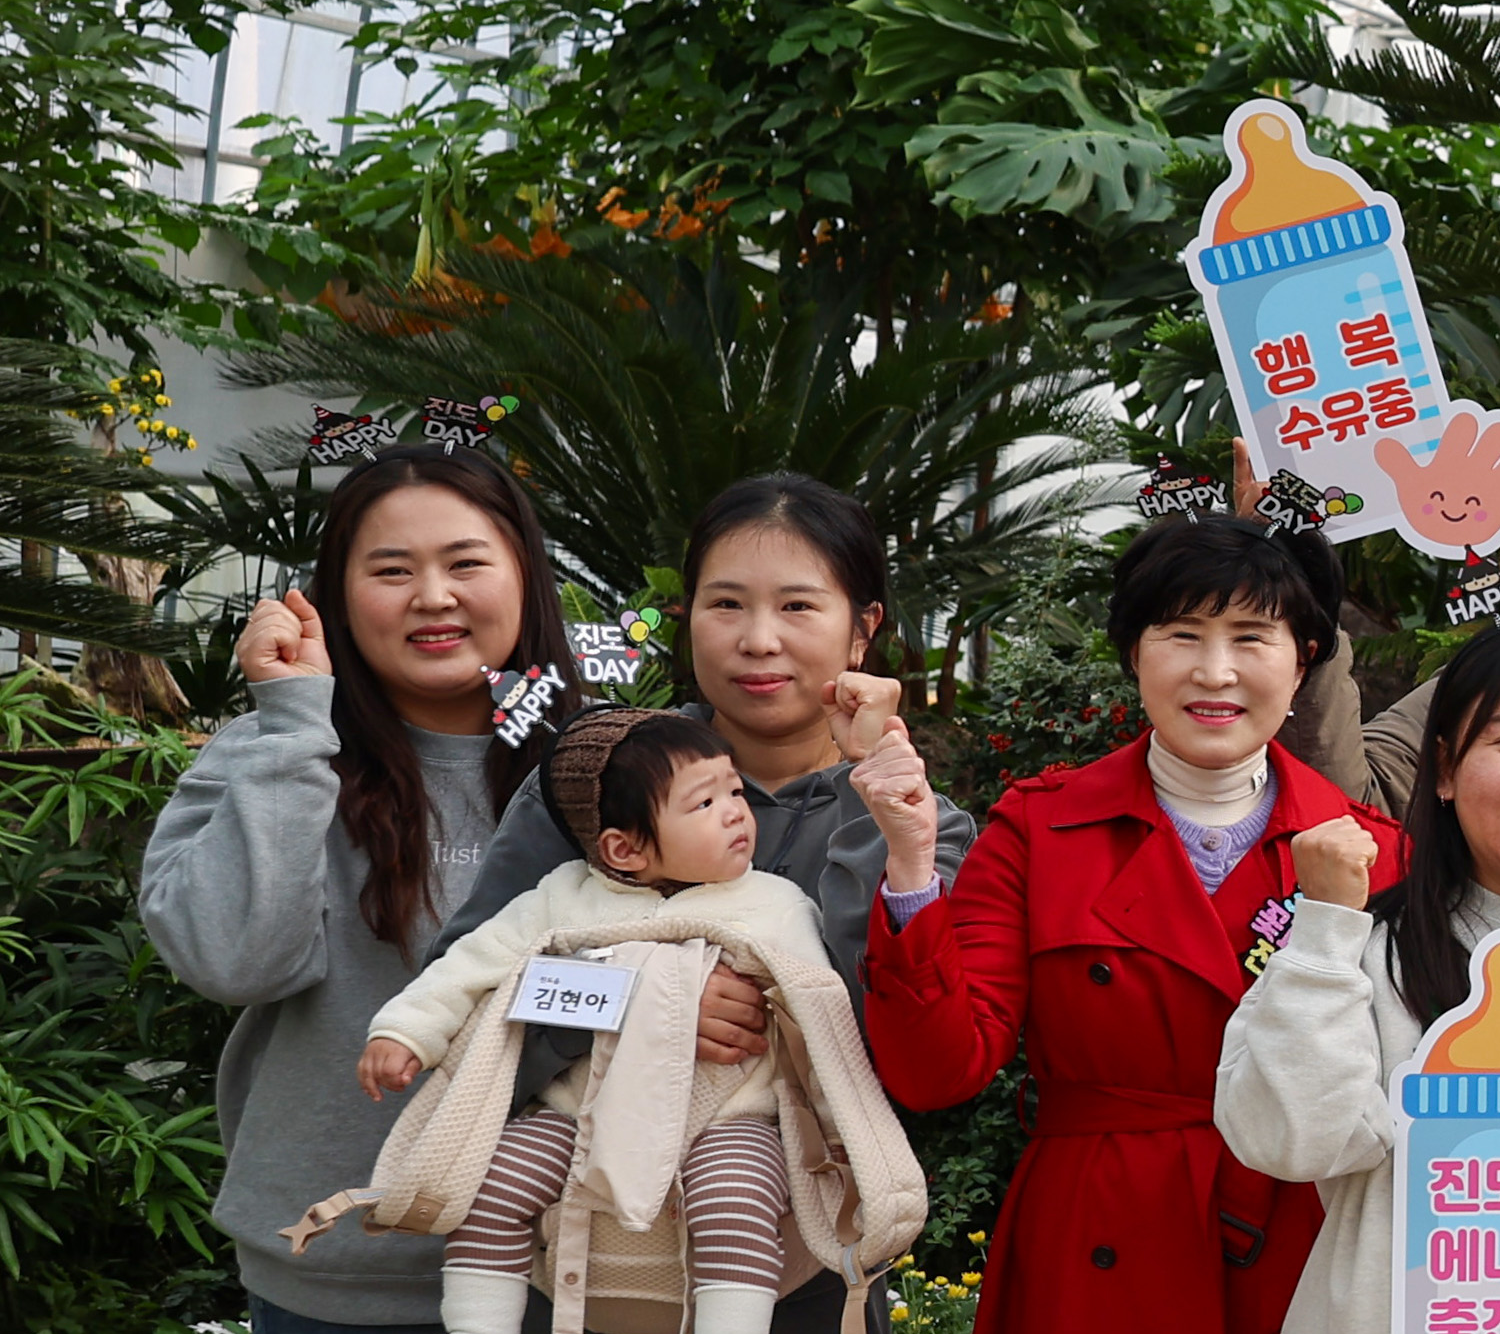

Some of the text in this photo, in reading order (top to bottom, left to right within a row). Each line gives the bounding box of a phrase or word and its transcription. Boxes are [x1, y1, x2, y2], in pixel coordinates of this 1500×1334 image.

[424, 397, 478, 424] 진도
[1278, 378, 1416, 451] 수유중
[311, 418, 395, 464] HAPPY
[424, 420, 486, 447] DAY
[1139, 483, 1226, 517] HAPPY
[1257, 495, 1316, 535] DAY
[573, 624, 626, 655] 진도
[584, 657, 639, 684] DAY
[499, 664, 565, 747] HAPPY
[534, 988, 608, 1013] 김현아
